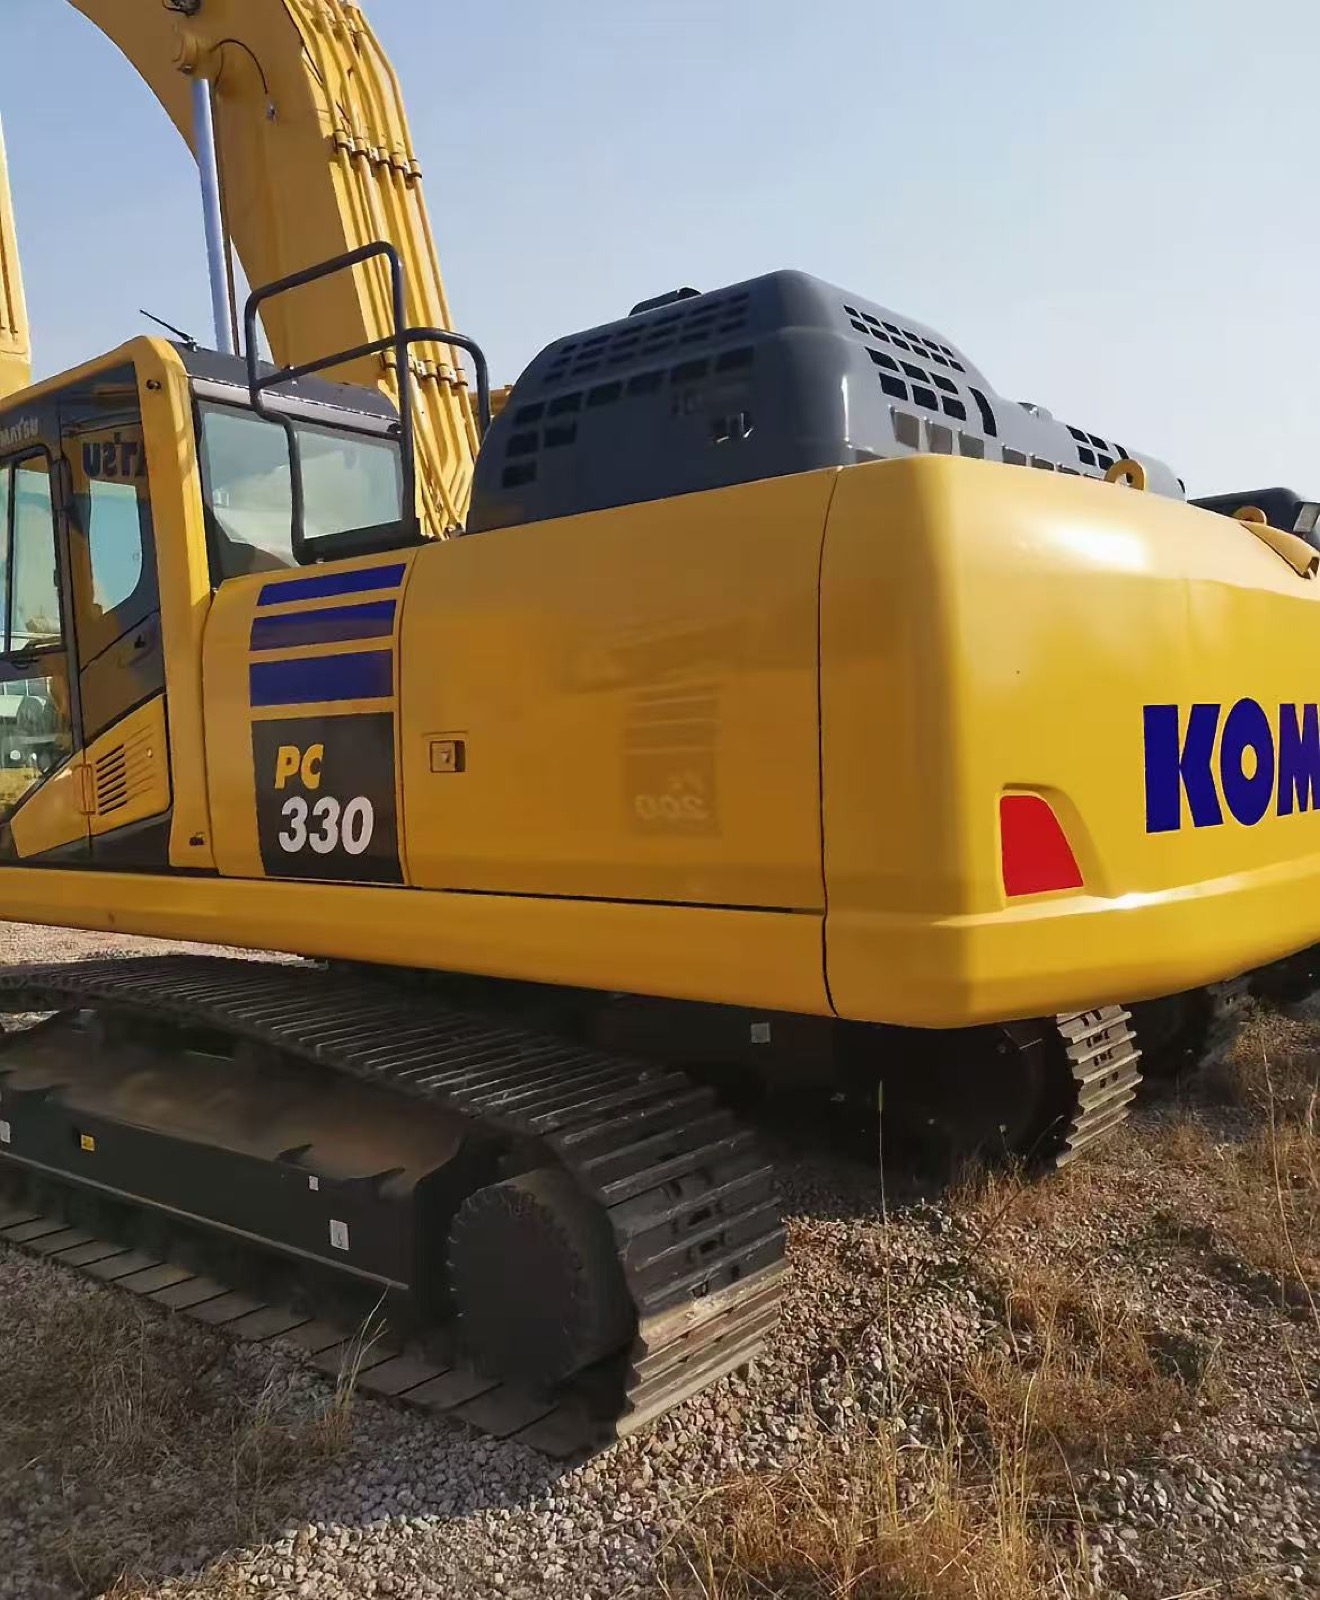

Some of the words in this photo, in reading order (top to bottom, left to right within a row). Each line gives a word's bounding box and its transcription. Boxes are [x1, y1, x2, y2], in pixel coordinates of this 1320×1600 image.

[275, 743, 324, 789] PC
[1143, 697, 1320, 833] KOM
[278, 796, 374, 854] 330
